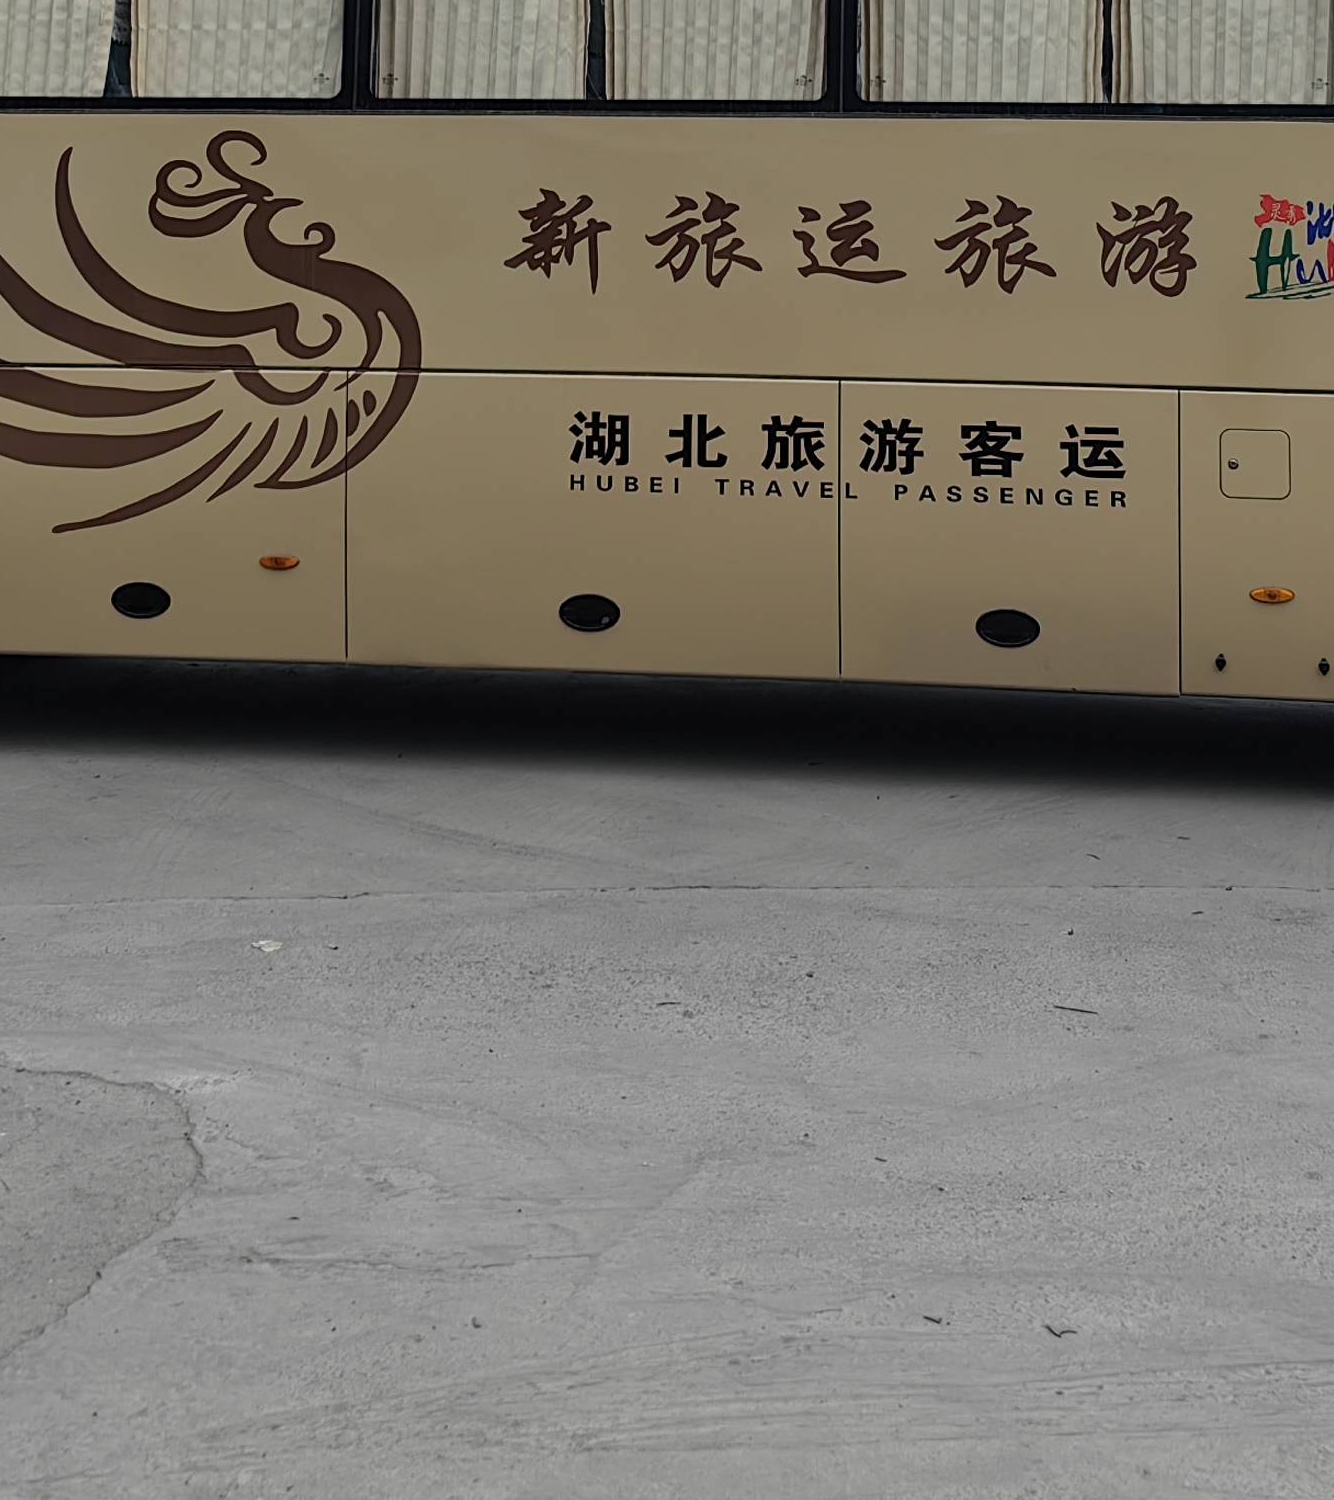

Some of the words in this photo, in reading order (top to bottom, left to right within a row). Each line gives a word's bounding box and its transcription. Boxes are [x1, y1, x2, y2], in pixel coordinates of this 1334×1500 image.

[503, 187, 1198, 298] 新旅运旅游
[568, 410, 1127, 479] 湖北旅游客运
[569, 474, 679, 494] HUBEI
[714, 478, 859, 500] TRAVEL
[894, 483, 1128, 509] PASSENGER
